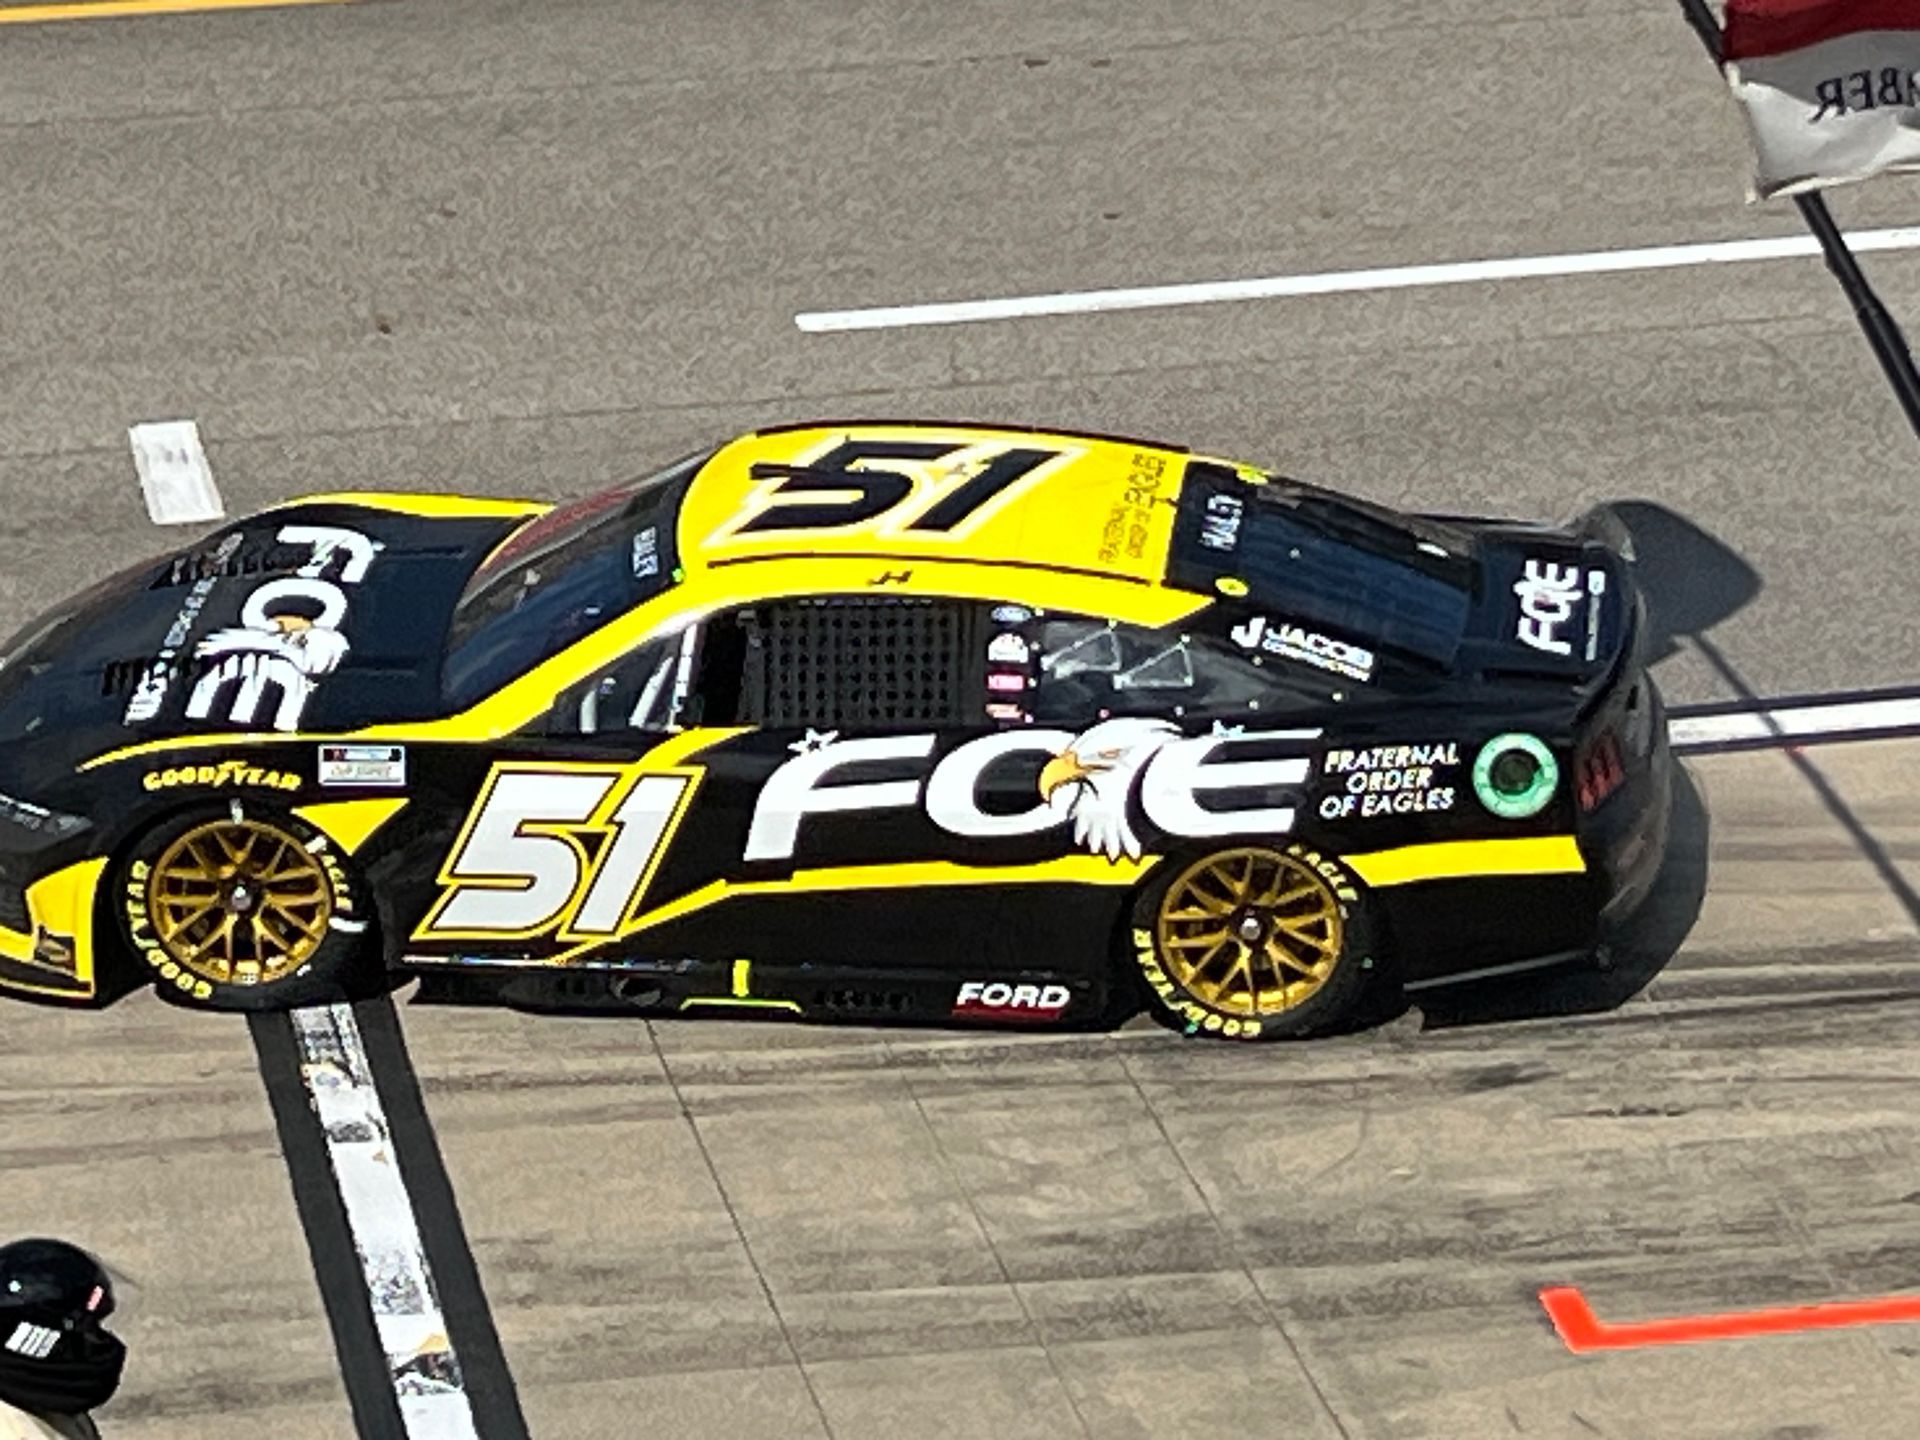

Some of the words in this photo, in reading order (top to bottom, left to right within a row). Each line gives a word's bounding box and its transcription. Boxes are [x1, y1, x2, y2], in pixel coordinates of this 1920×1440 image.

[720, 434, 1072, 539] 51
[1324, 743, 1460, 773] FRATERNAL
[143, 760, 302, 791] GOODYEAR
[1346, 767, 1433, 794] ORDER
[1319, 795, 1356, 820] OF
[1360, 787, 1456, 817] EAGLES
[412, 762, 704, 940] 51
[956, 982, 1071, 1008] FORD
